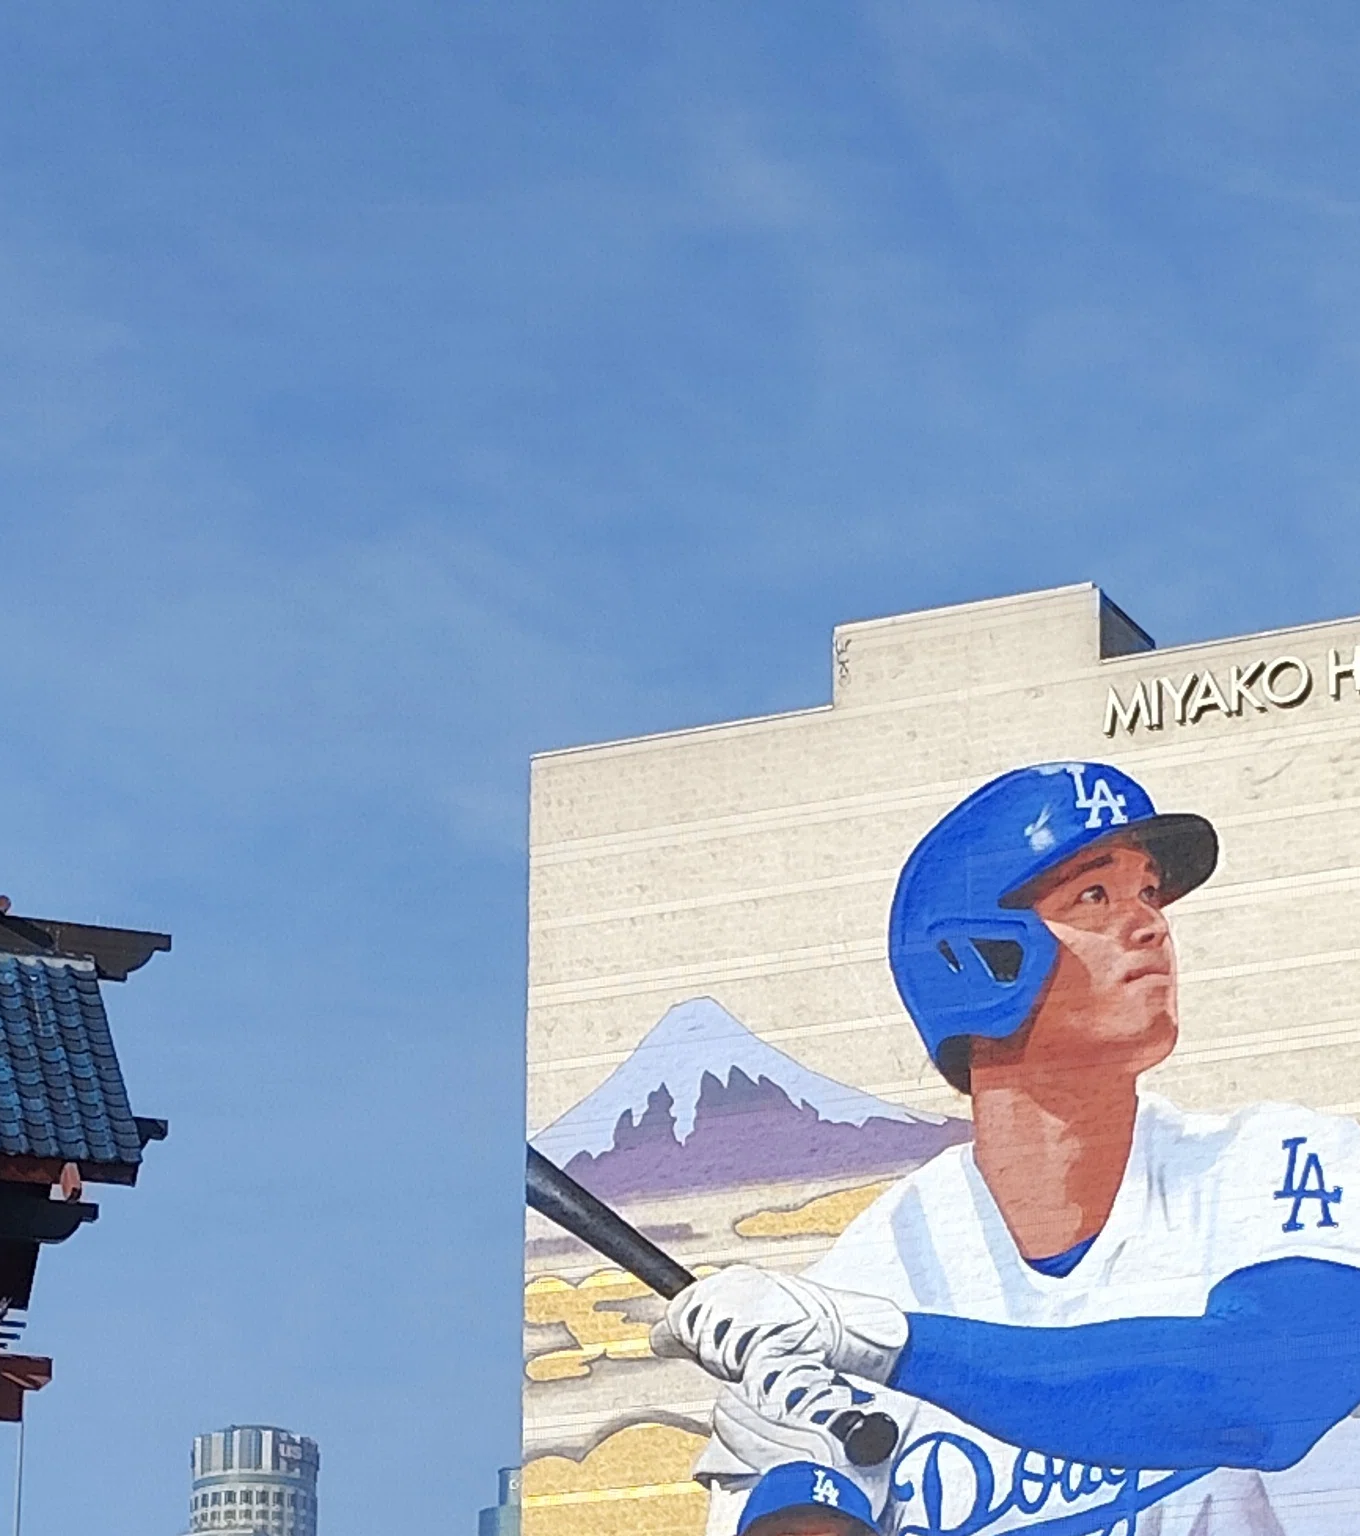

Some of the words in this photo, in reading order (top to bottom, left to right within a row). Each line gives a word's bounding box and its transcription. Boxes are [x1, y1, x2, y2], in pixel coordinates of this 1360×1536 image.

[1103, 655, 1313, 738] MIYAKO
[1065, 763, 1128, 829] LA
[1273, 1136, 1343, 1233] LA
[812, 1469, 840, 1507] LA
